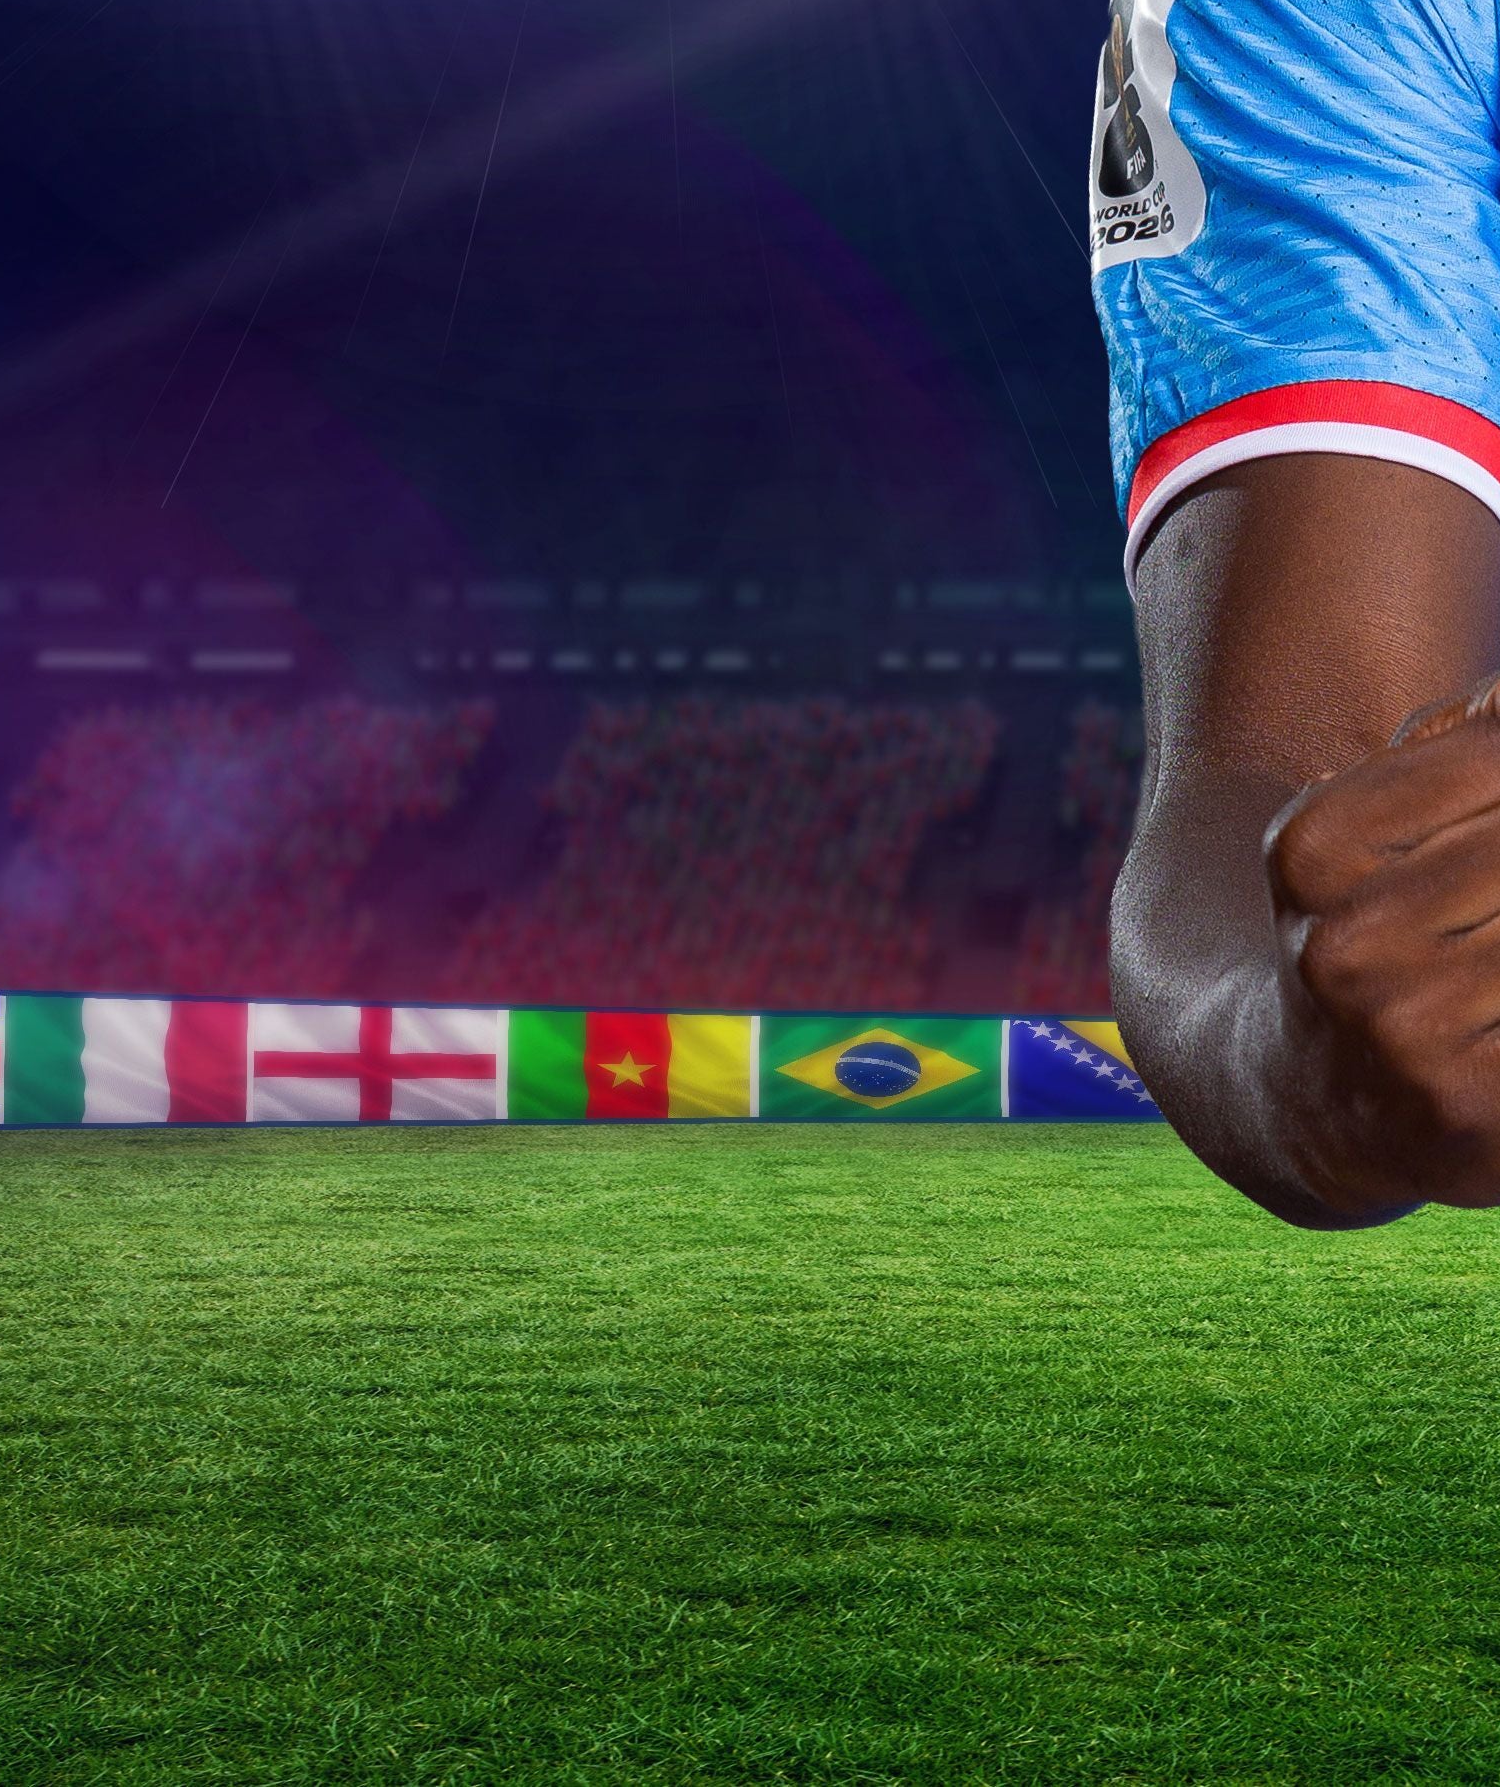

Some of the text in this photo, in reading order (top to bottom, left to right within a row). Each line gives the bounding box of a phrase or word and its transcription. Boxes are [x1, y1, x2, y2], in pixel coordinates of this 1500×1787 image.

[1126, 146, 1147, 179] FIFA
[1093, 181, 1166, 224] WORLD CUP
[1091, 204, 1174, 251] 2026
